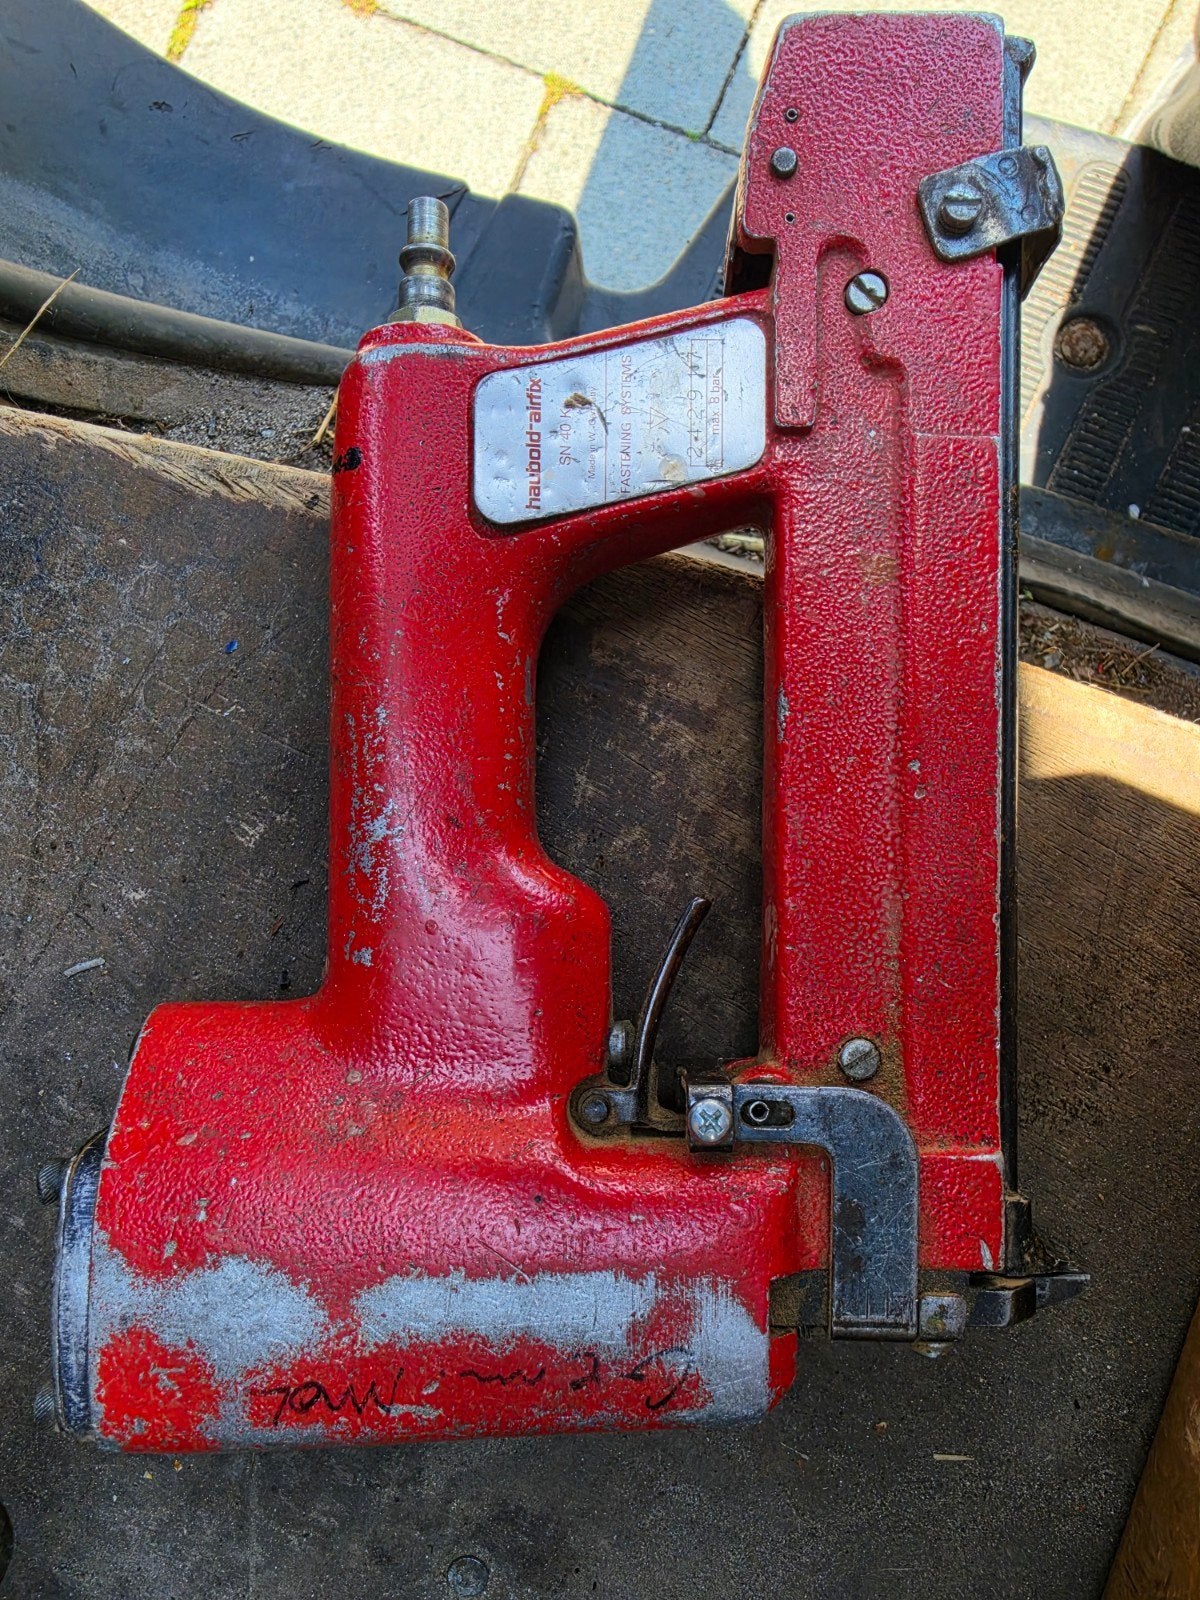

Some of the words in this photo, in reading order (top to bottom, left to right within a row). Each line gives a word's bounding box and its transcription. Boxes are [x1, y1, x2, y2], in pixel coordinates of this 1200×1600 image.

[620, 355, 632, 415] SYSTEMS
[709, 374, 721, 394] bar
[710, 395, 721, 405] 8
[559, 408, 571, 419] K
[559, 423, 571, 440] 40
[526, 377, 541, 509] haubold-airfix
[587, 444, 596, 454] in
[559, 445, 571, 466] SN
[620, 422, 632, 493] FASTENING
[587, 455, 596, 479] Made
